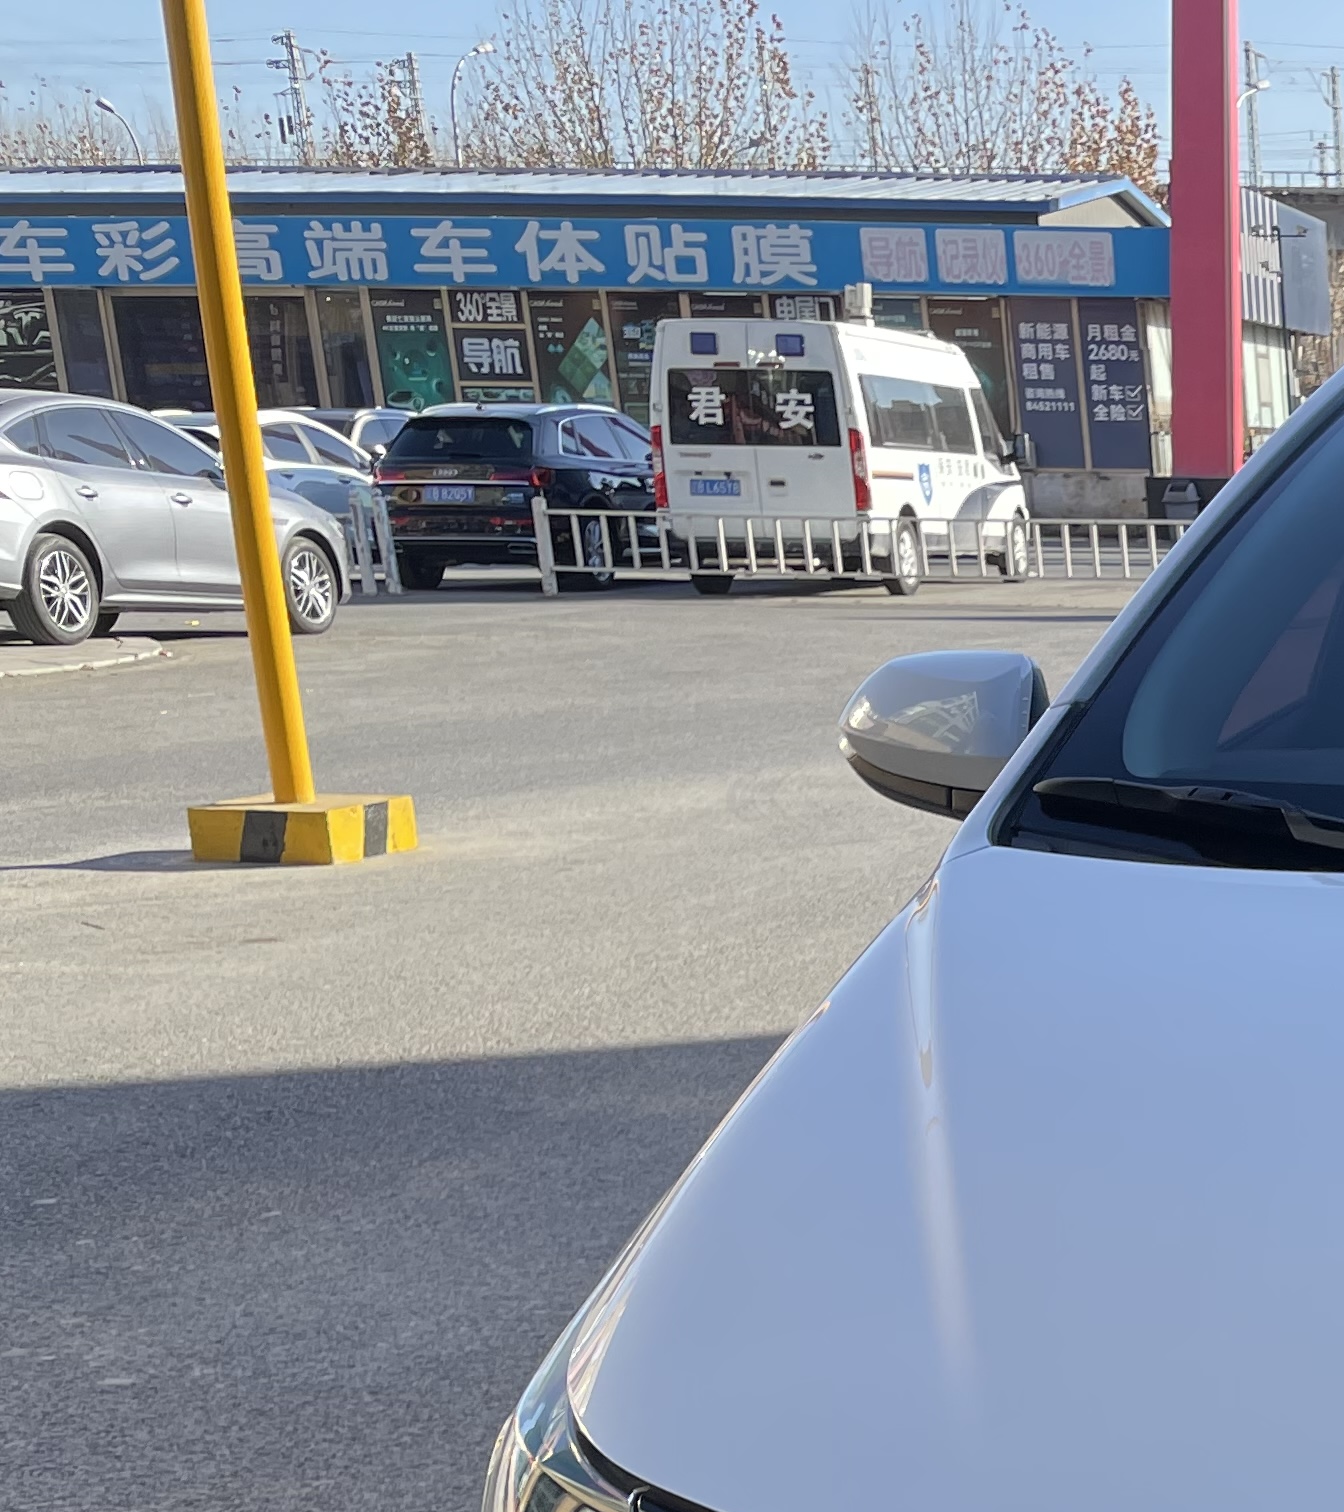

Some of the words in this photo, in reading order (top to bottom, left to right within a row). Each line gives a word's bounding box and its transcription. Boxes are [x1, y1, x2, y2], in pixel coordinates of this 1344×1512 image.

[0, 219, 818, 286] 车彩高端车体贴膜
[866, 235, 927, 281] 导航
[941, 236, 1006, 284] 记录仪
[1019, 322, 1069, 340] 新能源
[1087, 323, 1137, 342] 月租金
[462, 336, 525, 376] 导航
[1020, 342, 1071, 361] 商用车
[1087, 343, 1140, 361] 2680元
[1022, 362, 1056, 380] 租售
[1089, 363, 1108, 381] 起
[1090, 383, 1125, 401] 新车
[1092, 403, 1127, 422] 全险
